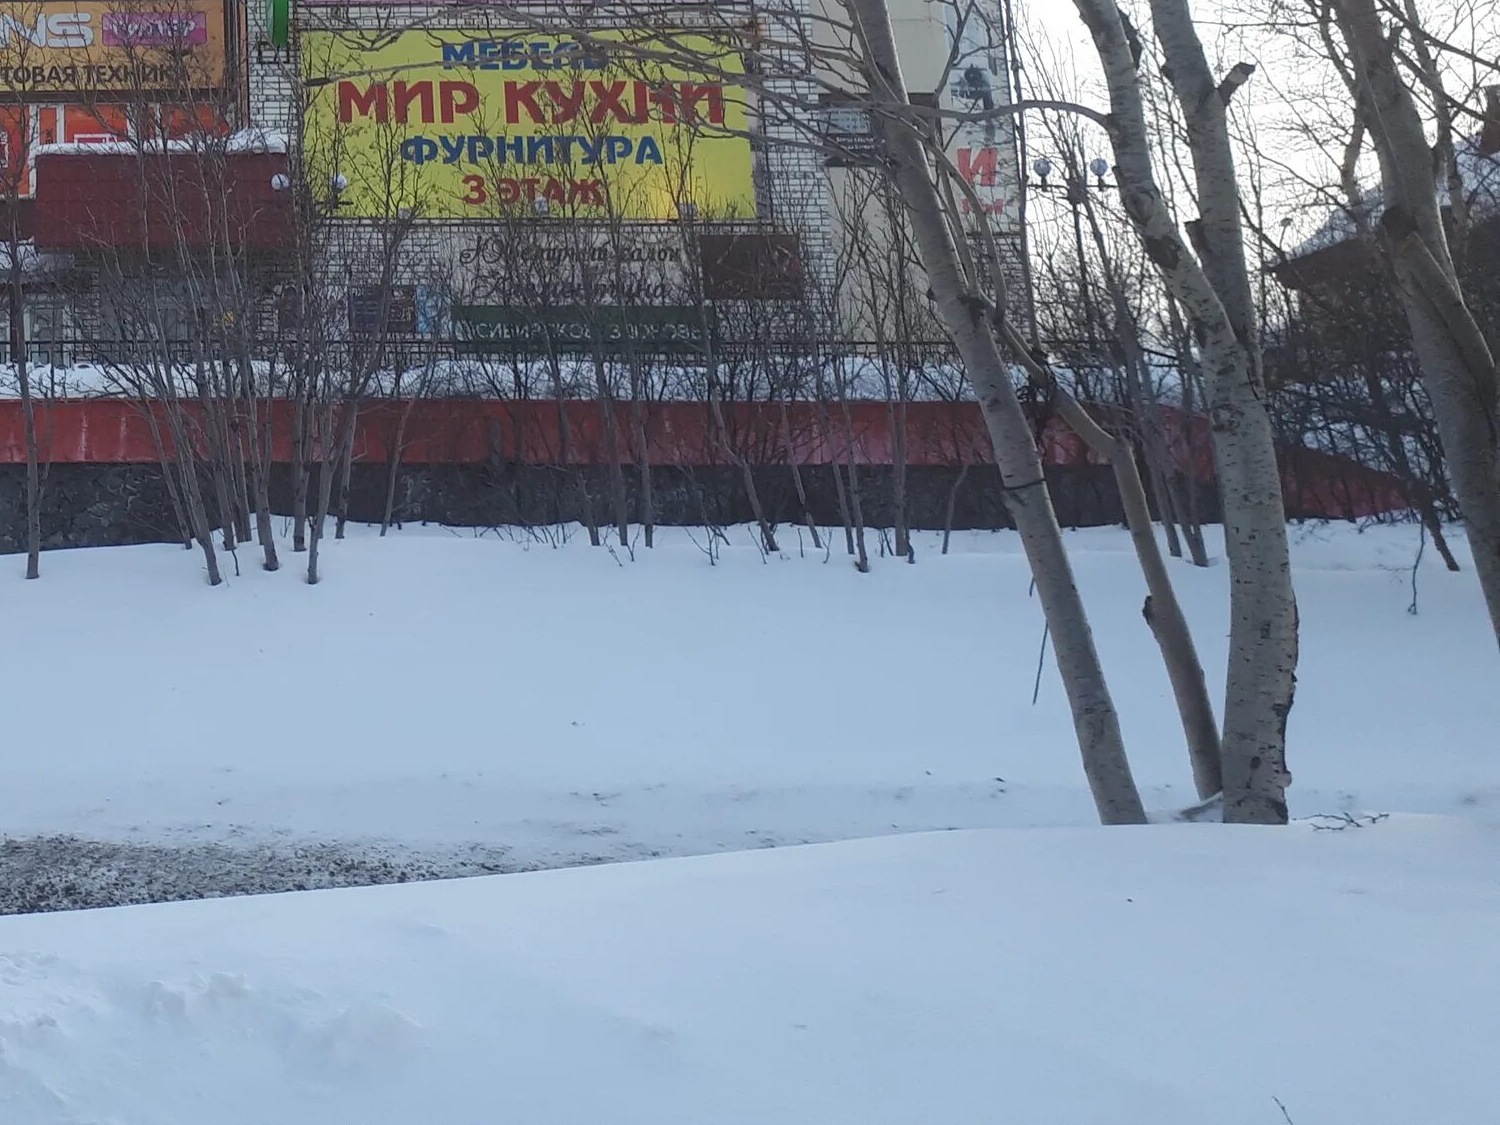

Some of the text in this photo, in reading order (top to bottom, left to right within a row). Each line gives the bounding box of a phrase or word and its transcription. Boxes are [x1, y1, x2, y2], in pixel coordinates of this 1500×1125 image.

[338, 80, 724, 125] МИР КУХНИ
[401, 134, 664, 165] ФУРНИТУРА
